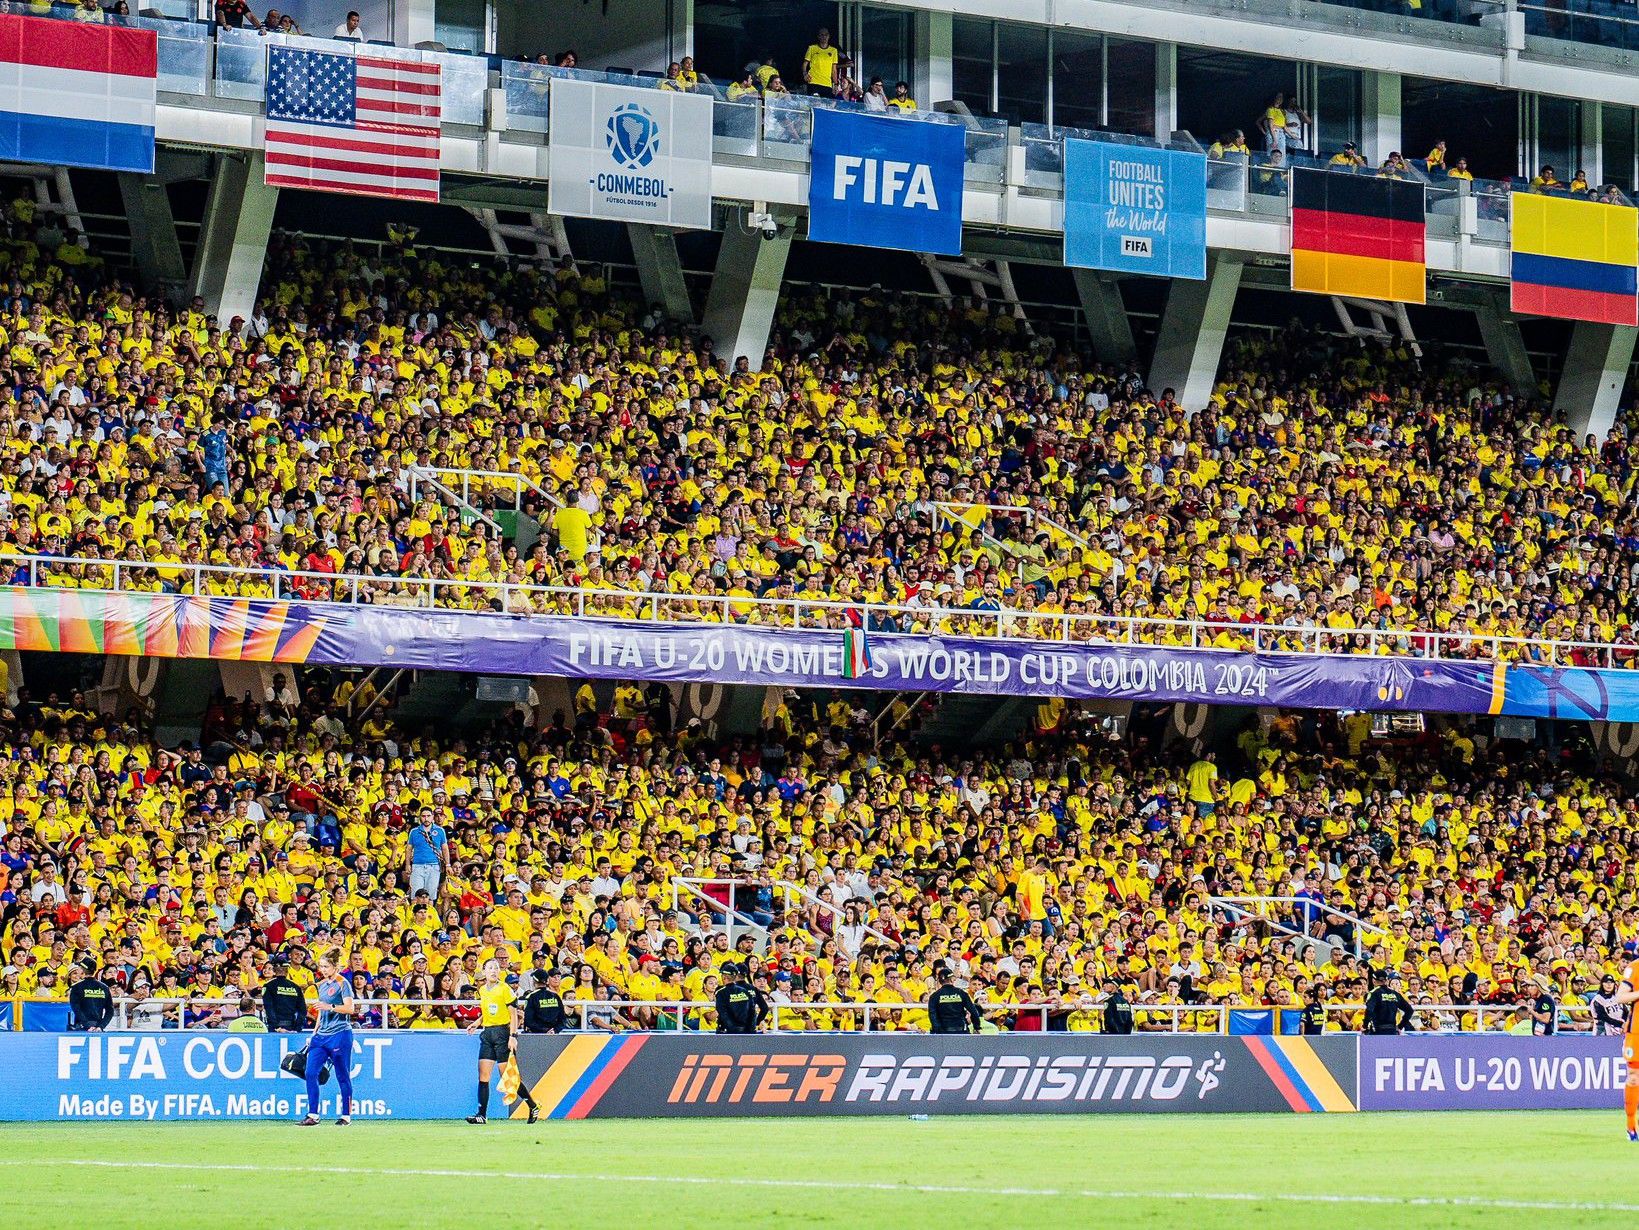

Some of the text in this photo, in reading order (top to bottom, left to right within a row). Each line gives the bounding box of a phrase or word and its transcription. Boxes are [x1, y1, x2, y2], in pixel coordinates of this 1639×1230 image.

[597, 173, 668, 198] CONMEBOL
[833, 154, 939, 211] FIFA
[1109, 160, 1164, 183] FOOTBALL
[1109, 181, 1164, 210] UNITES
[1104, 207, 1168, 236] the World
[1125, 240, 1148, 252] FIFA
[569, 633, 644, 668] FIFA
[654, 637, 725, 671] U-20
[900, 646, 1010, 682] WORLD
[1020, 653, 1078, 686] CUP
[1086, 656, 1207, 693] COLOMBIA
[1375, 1057, 1446, 1092] FIFA
[1455, 1057, 1522, 1091] U-20
[59, 1094, 124, 1116] Made
[130, 1094, 159, 1121] By
[164, 1094, 221, 1116] FIFA.
[226, 1094, 290, 1116] Made
[295, 1094, 331, 1116] Fr
